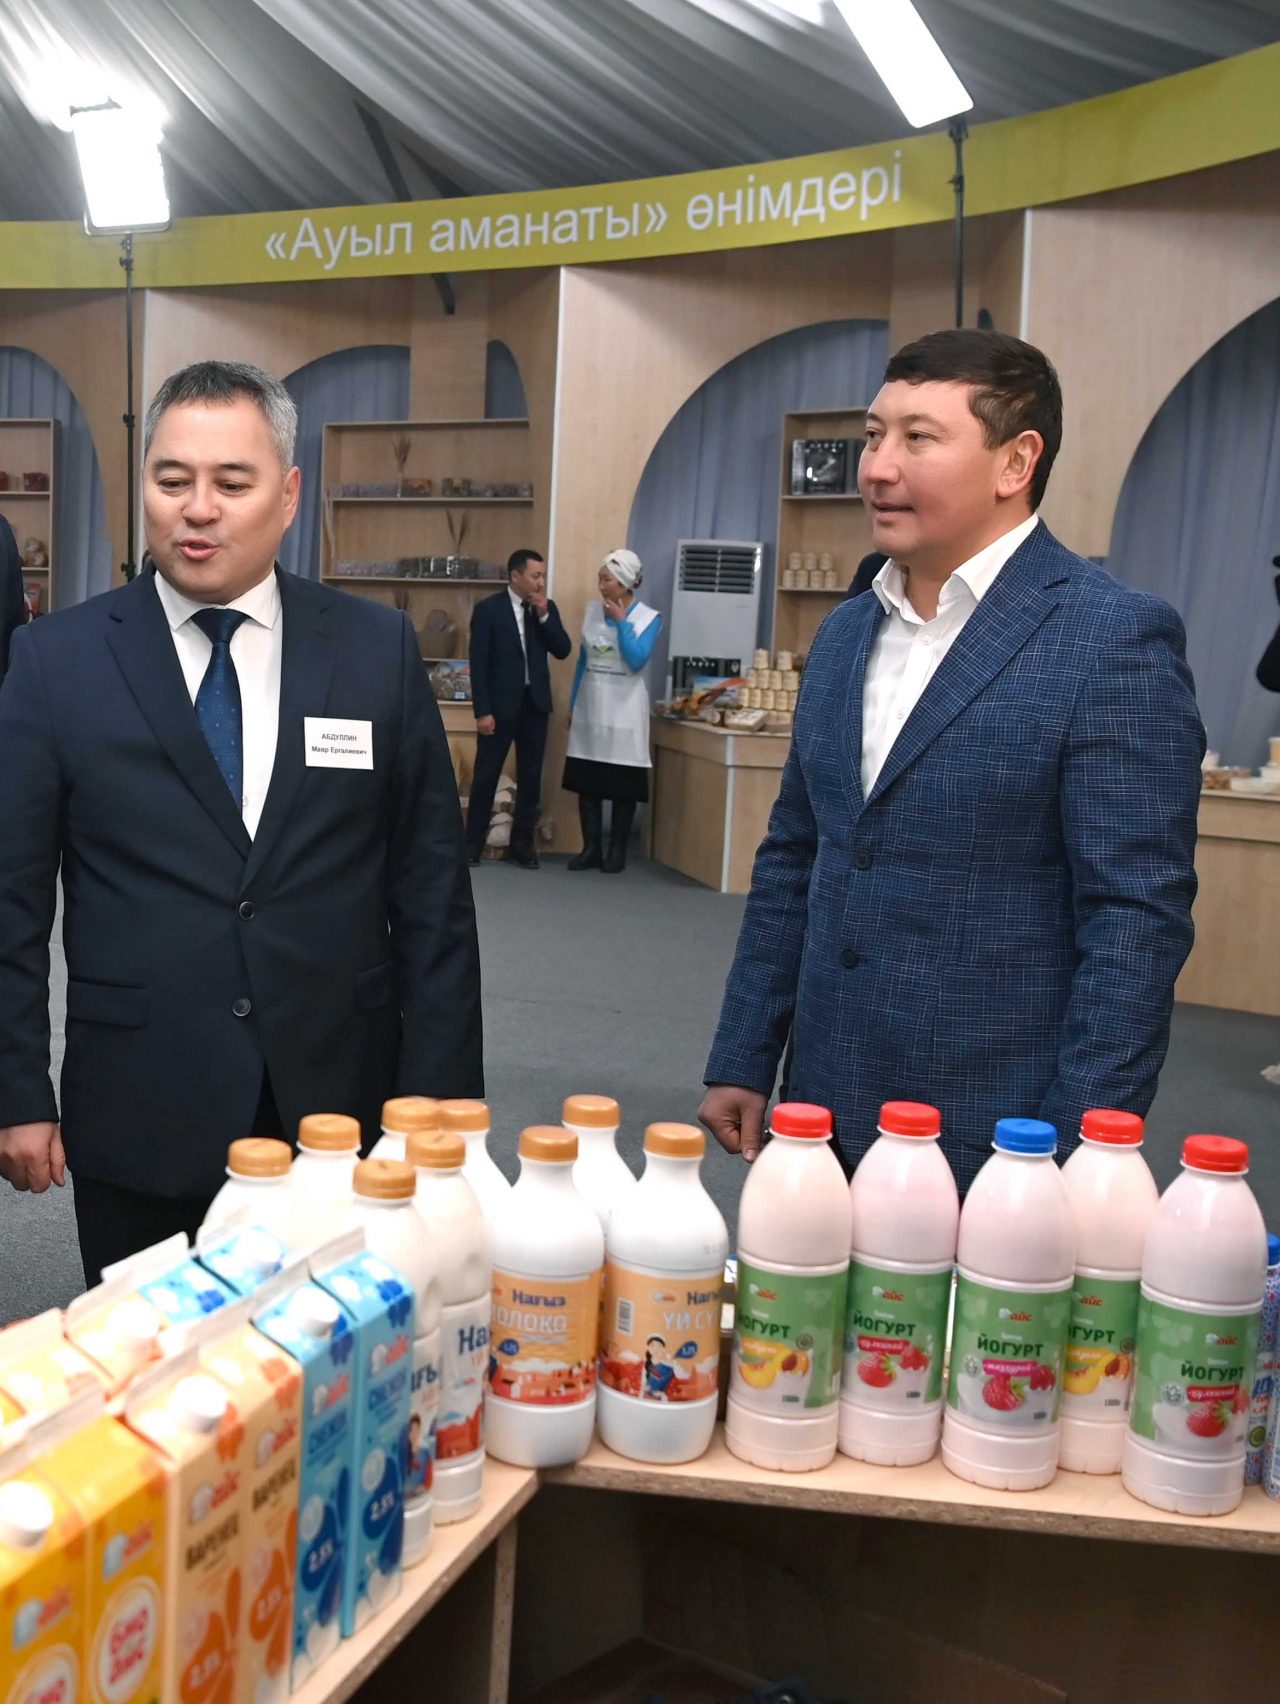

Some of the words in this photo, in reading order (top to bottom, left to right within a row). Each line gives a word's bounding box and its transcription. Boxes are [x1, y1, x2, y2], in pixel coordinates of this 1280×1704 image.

[265, 217, 413, 270] «Ауыл
[429, 202, 669, 252] аманаты»
[687, 150, 902, 231] өнімдері
[321, 733, 358, 742] АБДУЛЛИН
[854, 1310, 916, 1336] ЙОГУРТ
[1068, 1325, 1116, 1343] ГУРТ
[977, 1333, 1044, 1357] ЙОГУРТ
[1181, 1360, 1245, 1381] ЙОГУРТ
